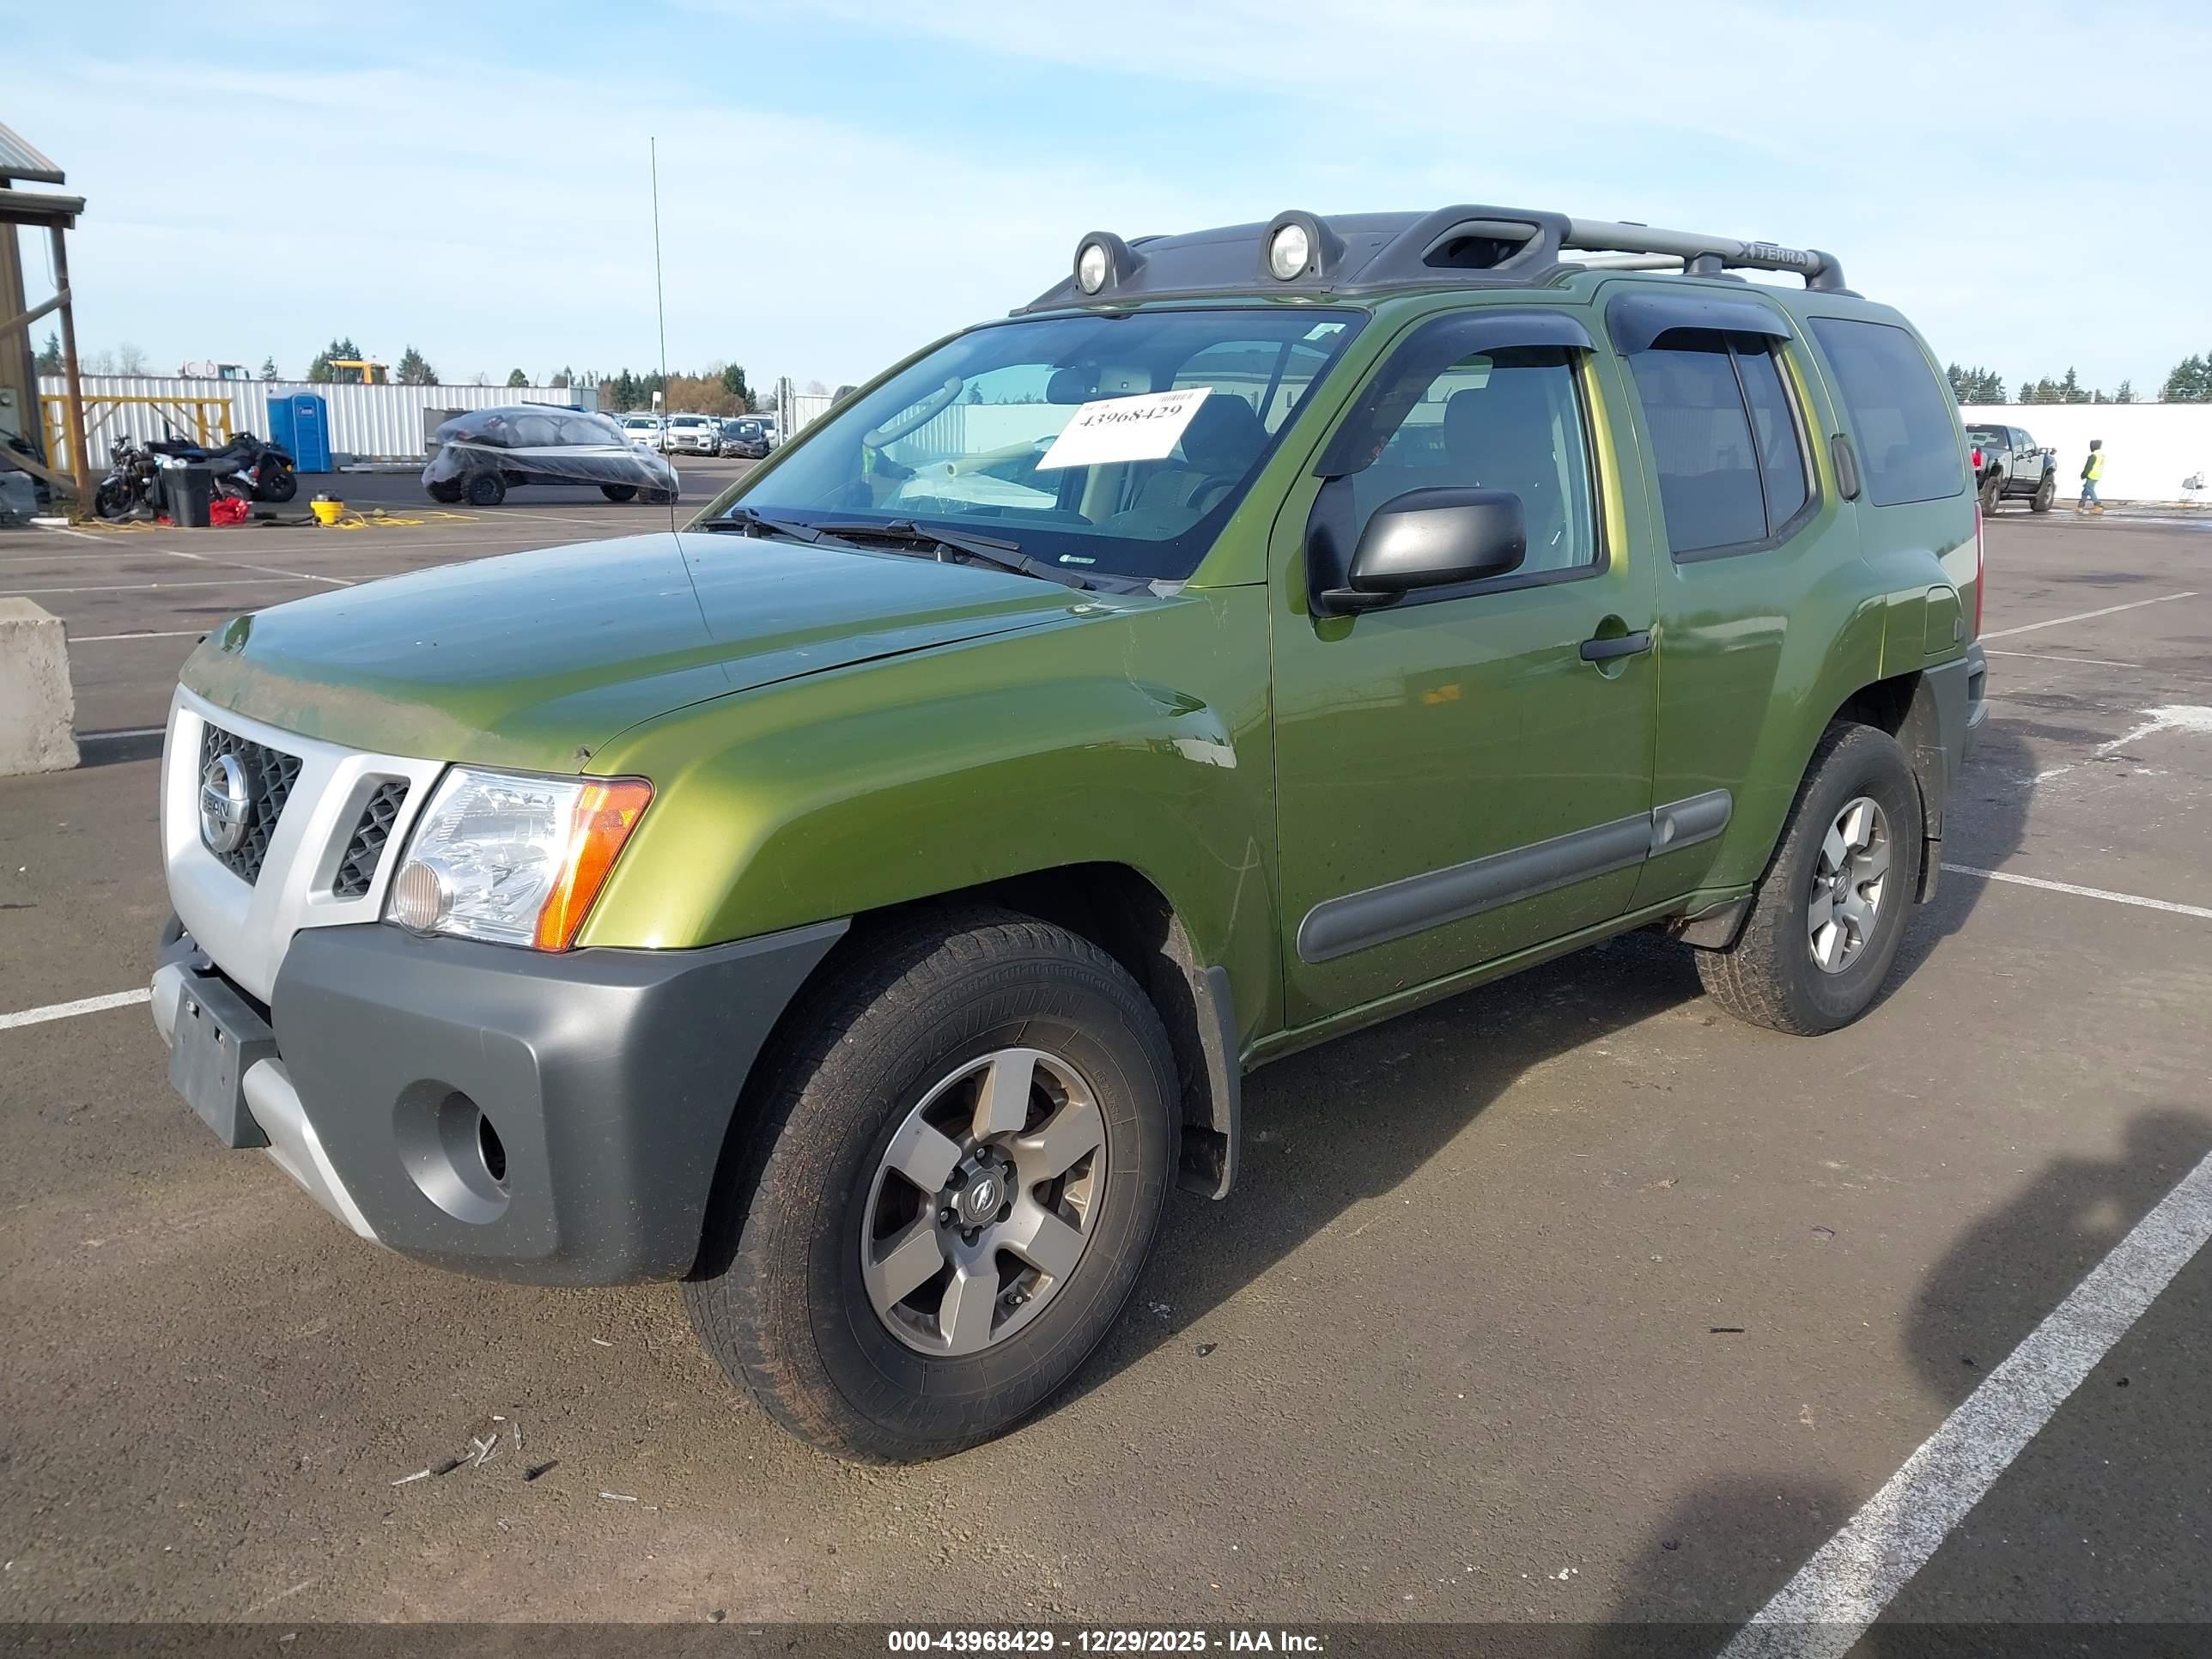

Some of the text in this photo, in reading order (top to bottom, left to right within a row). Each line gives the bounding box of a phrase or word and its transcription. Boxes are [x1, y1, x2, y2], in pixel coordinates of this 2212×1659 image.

[1736, 241, 1808, 266] XTERRA
[1079, 404, 1182, 428] 43968429
[893, 988, 1085, 1093] SAILUN
